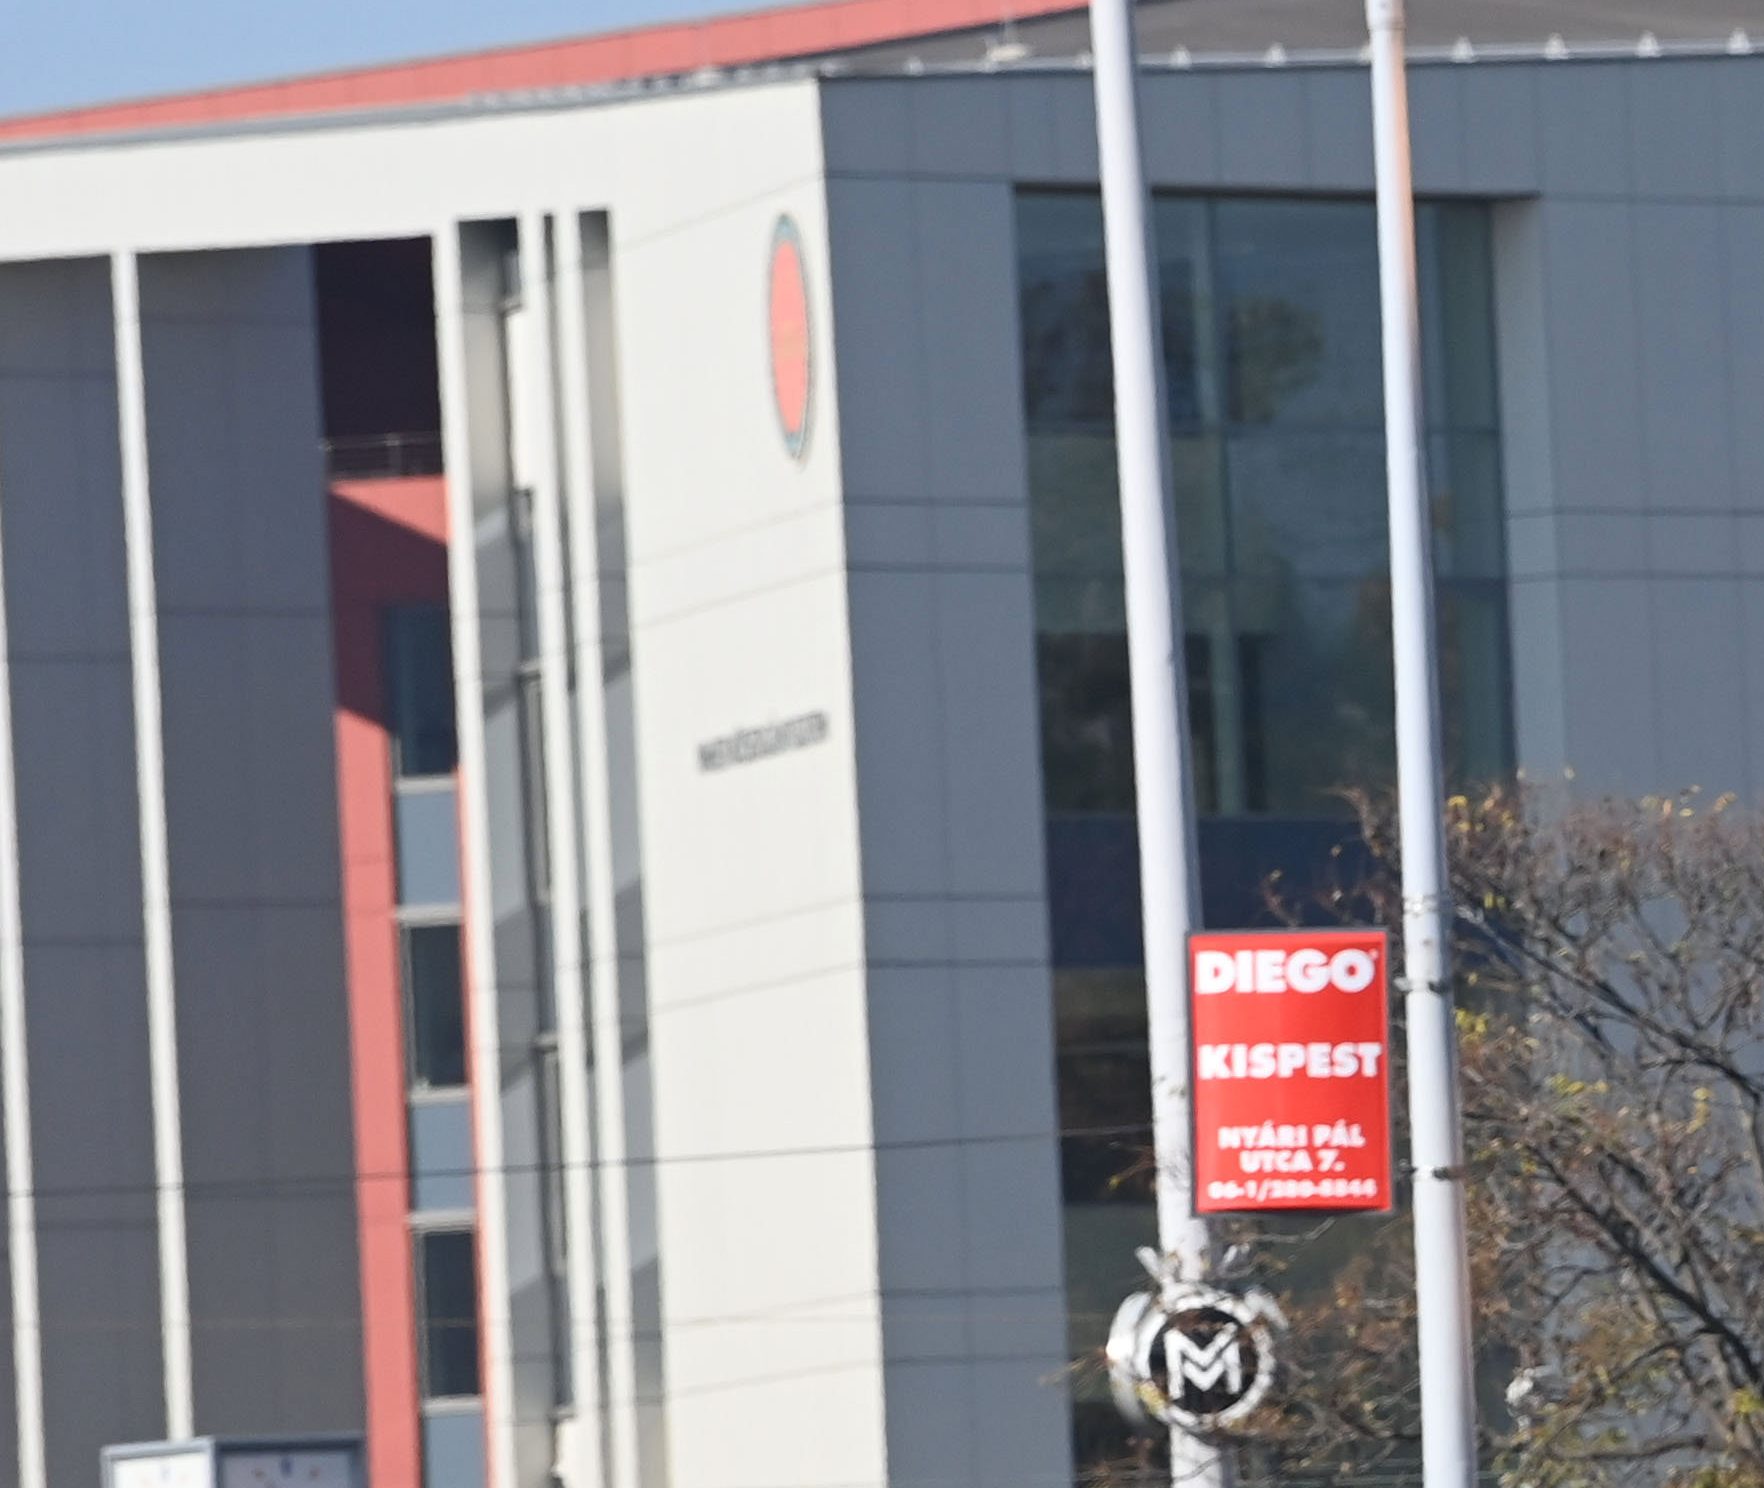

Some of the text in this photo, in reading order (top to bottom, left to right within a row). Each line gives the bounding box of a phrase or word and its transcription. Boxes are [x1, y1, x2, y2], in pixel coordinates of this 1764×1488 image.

[1195, 948, 1375, 995] DIEGO
[1198, 1042, 1382, 1079] KISPEST
[1311, 1118, 1366, 1148] PÁL
[1239, 1149, 1346, 1173] UTCA 7.
